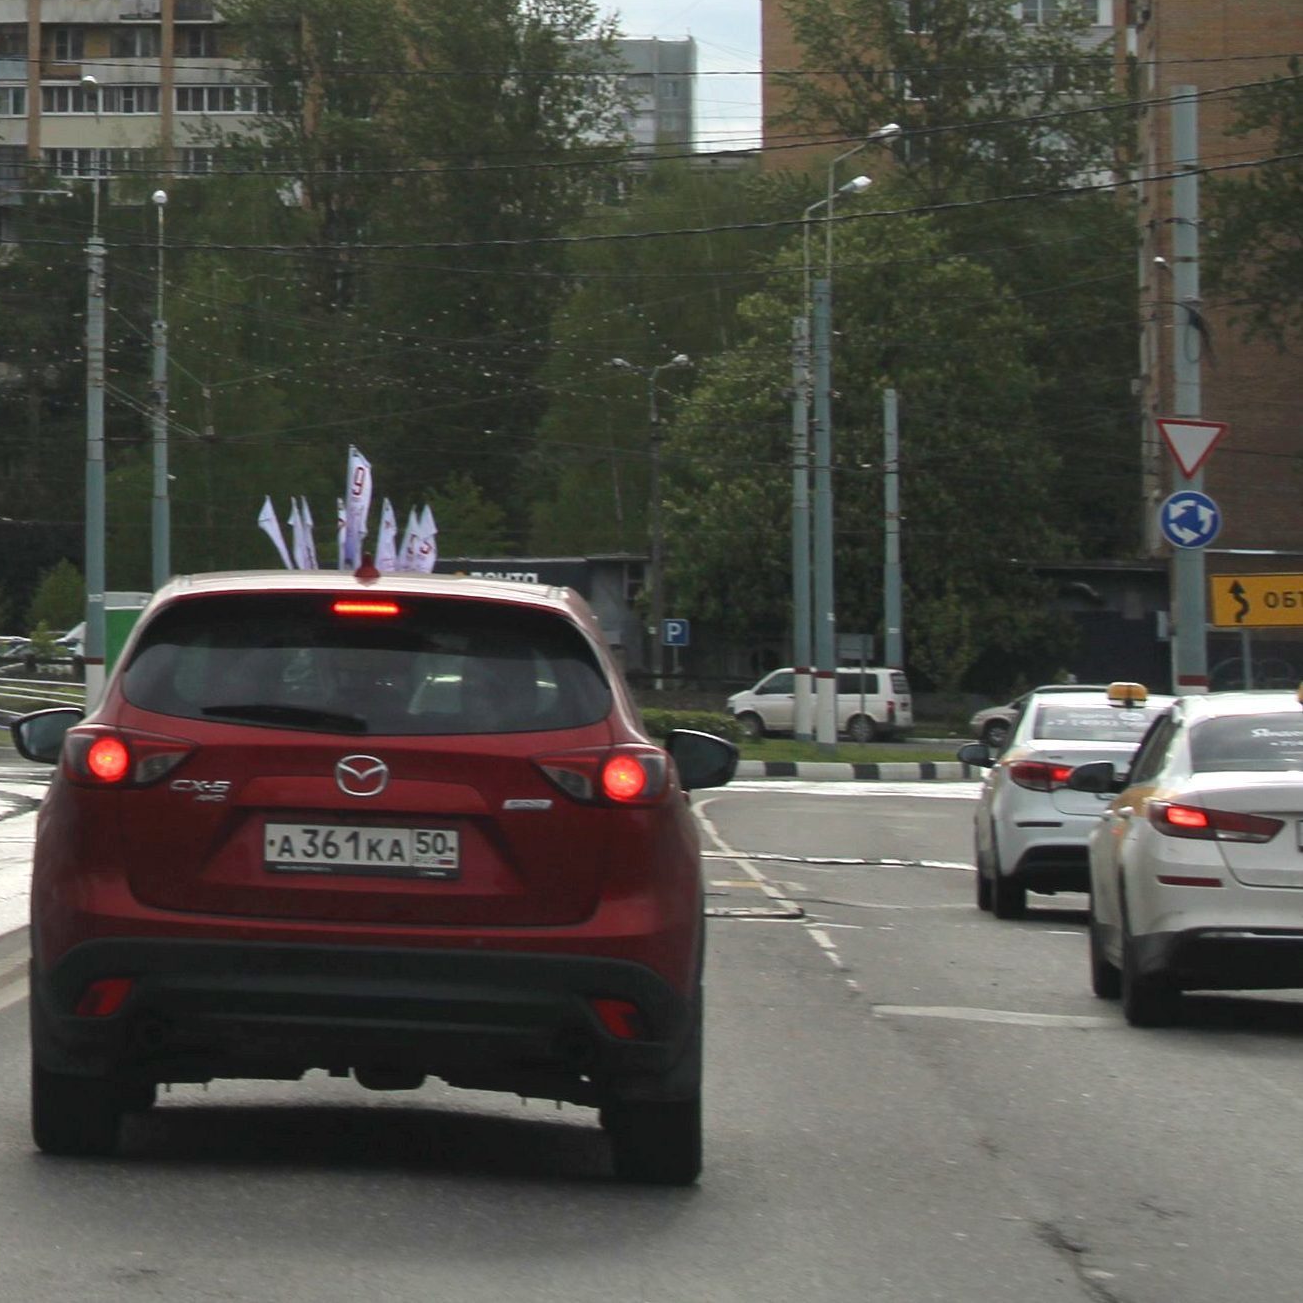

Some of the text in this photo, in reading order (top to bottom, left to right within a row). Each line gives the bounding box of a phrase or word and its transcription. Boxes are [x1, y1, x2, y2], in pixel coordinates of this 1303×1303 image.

[1264, 591, 1303, 609] ОБ
[171, 779, 231, 792] CX-5
[416, 832, 446, 855] 50
